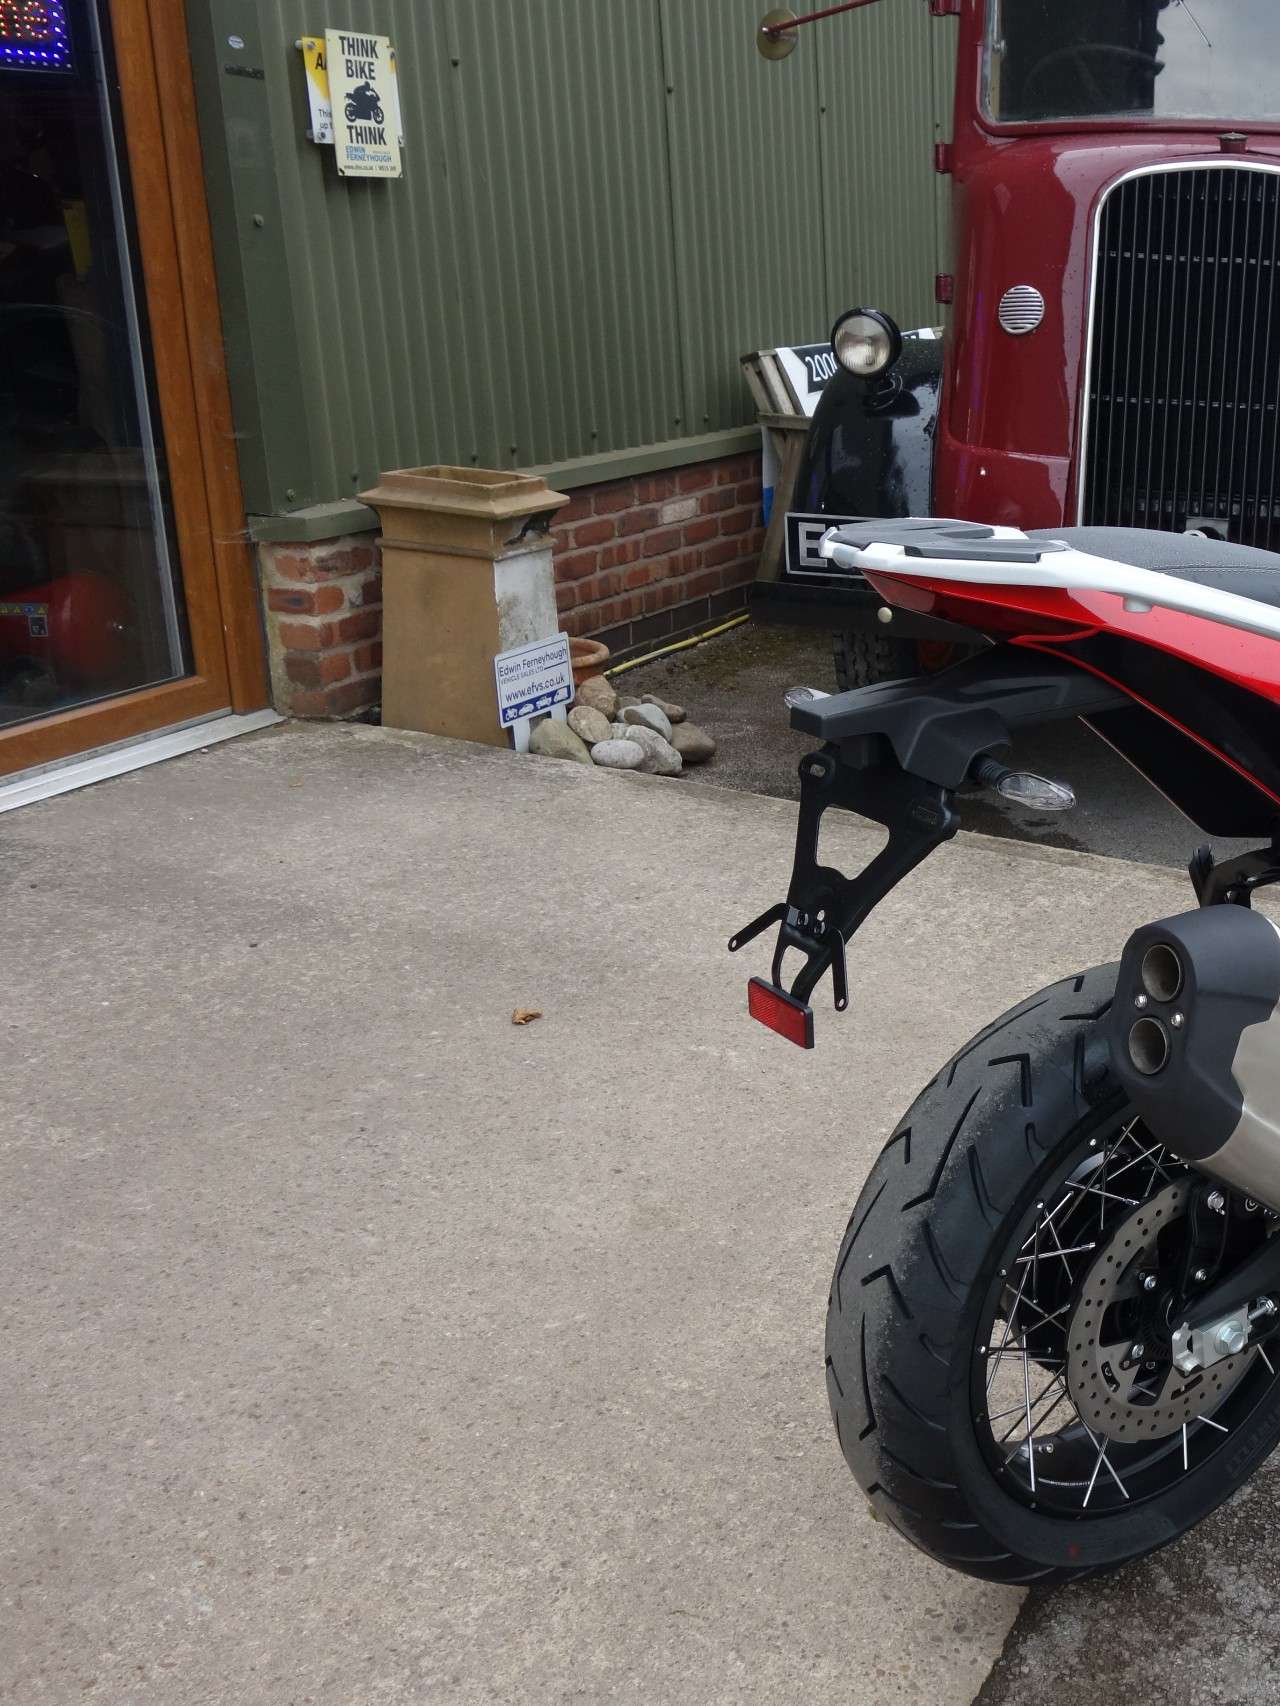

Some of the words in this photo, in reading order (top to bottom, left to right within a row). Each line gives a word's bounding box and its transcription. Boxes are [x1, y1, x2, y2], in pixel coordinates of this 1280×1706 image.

[338, 36, 379, 59] THINK
[345, 59, 376, 80] BIKE
[346, 125, 387, 145] THINK
[499, 663, 522, 678] Edwin
[522, 647, 567, 669] Ferneyhough
[505, 672, 565, 702] www.efvs.co.uk
